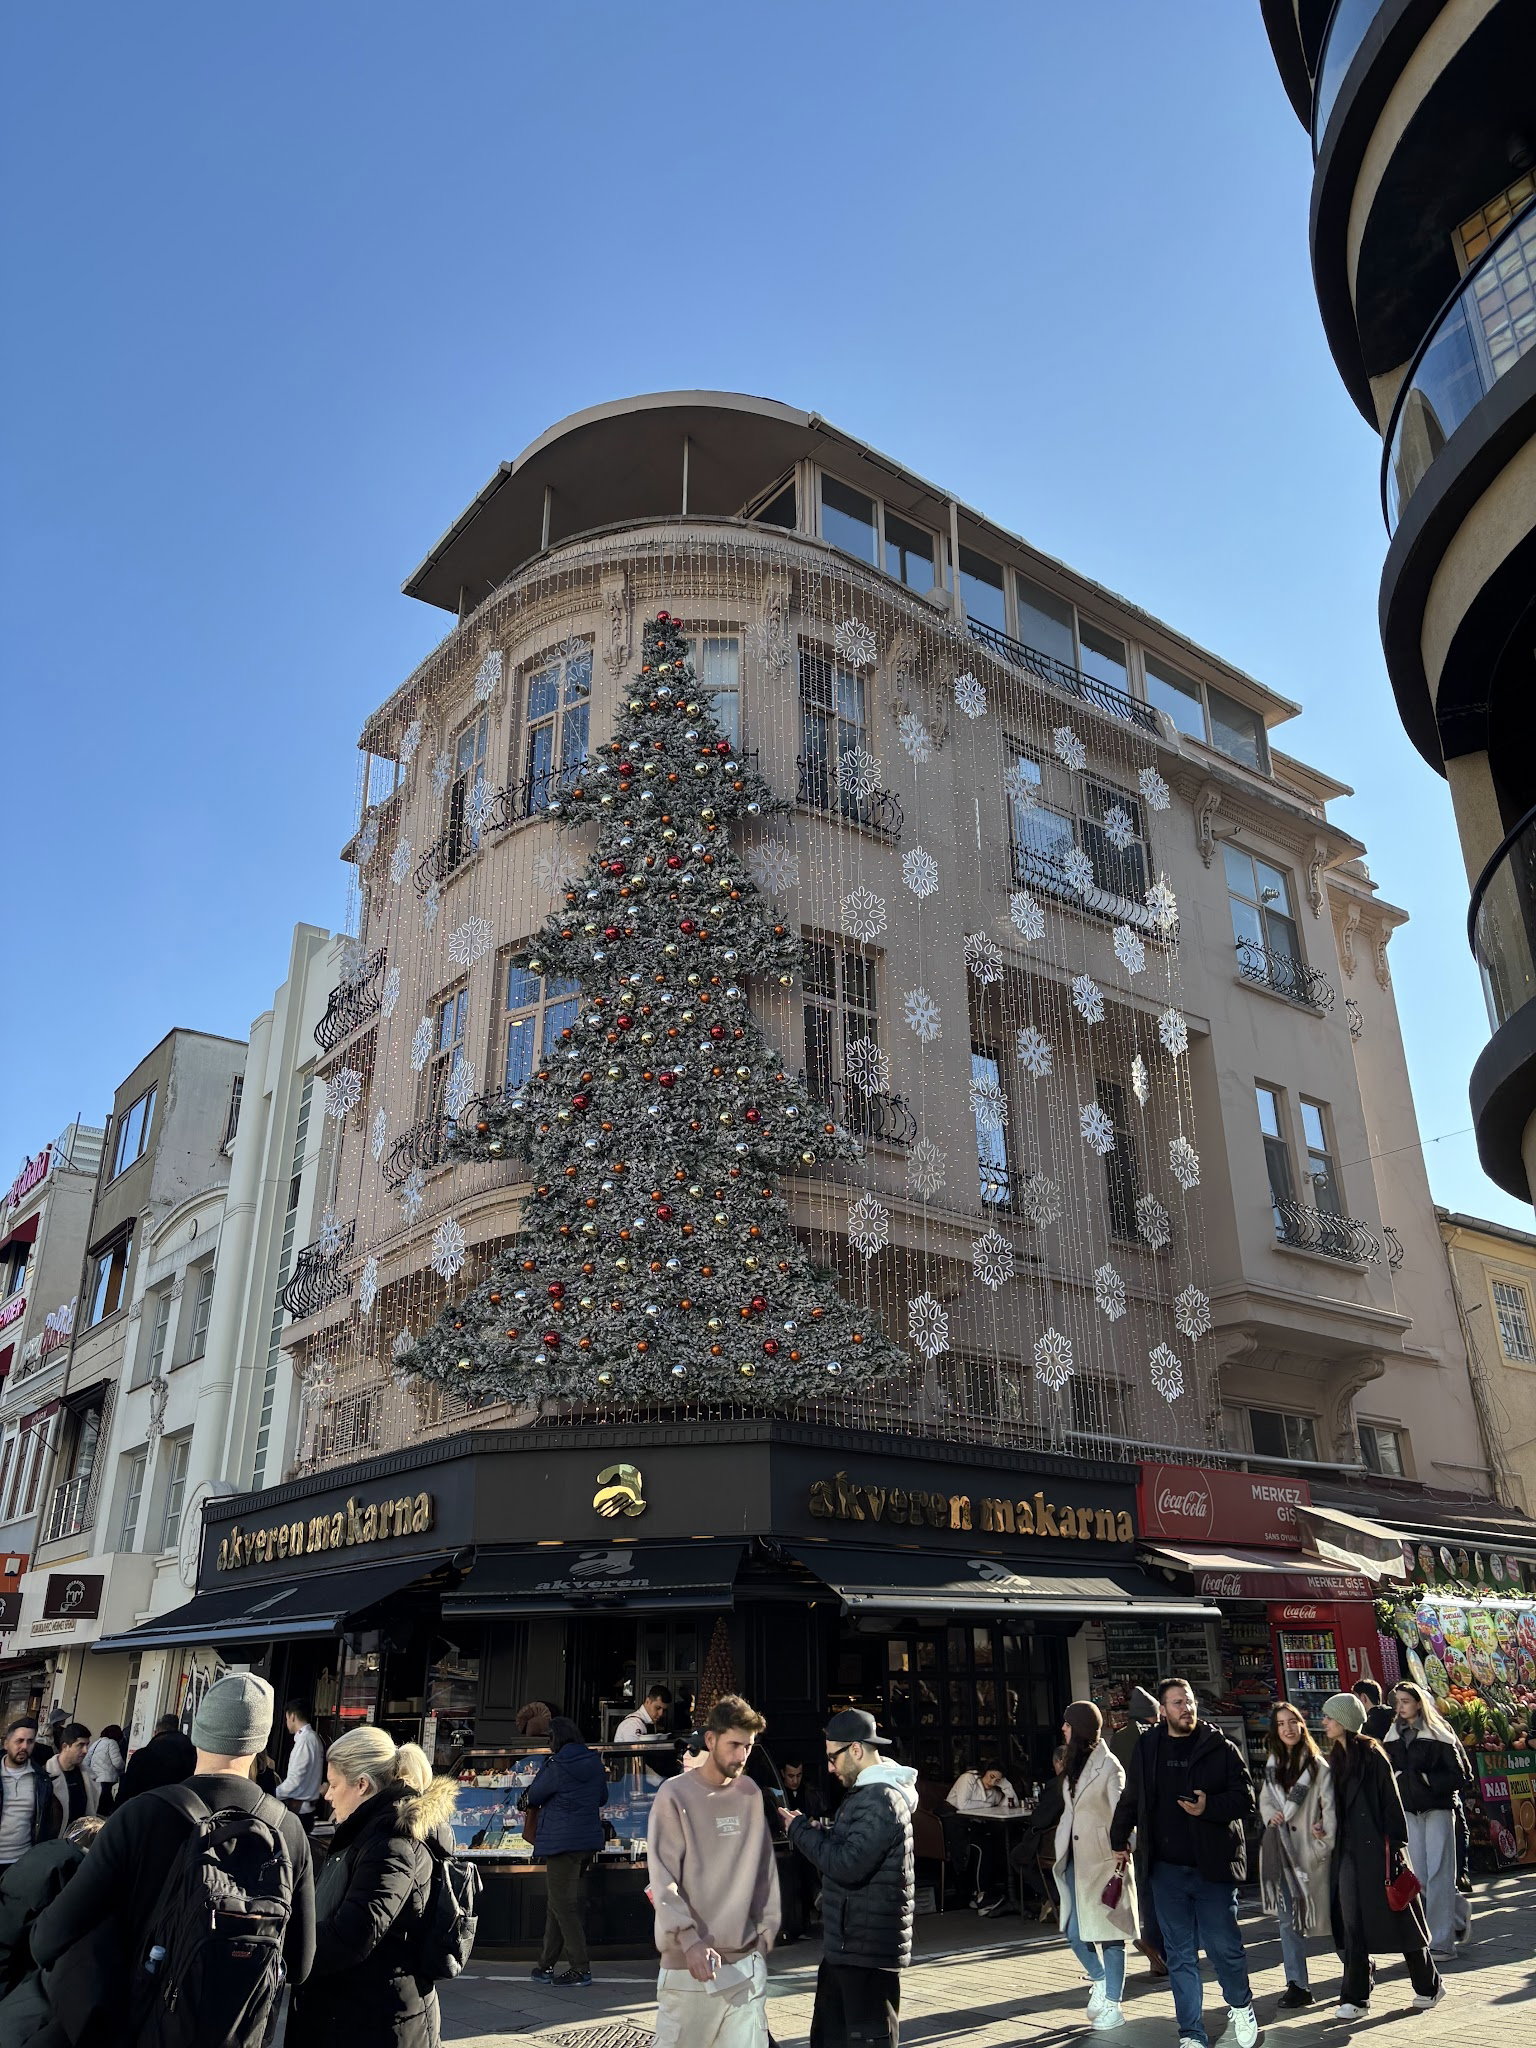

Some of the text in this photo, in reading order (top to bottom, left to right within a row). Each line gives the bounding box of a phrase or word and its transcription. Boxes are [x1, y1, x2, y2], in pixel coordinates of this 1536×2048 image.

[1251, 1484, 1302, 1504] MERKEZ
[808, 1470, 1134, 1543] akveren makarna
[1276, 1506, 1297, 1526] GİŞ
[216, 1492, 432, 1572] akveren makarna
[535, 1579, 650, 1591] akveren
[1307, 1576, 1344, 1588] MERKEZ
[1484, 1781, 1509, 1798] NAR
